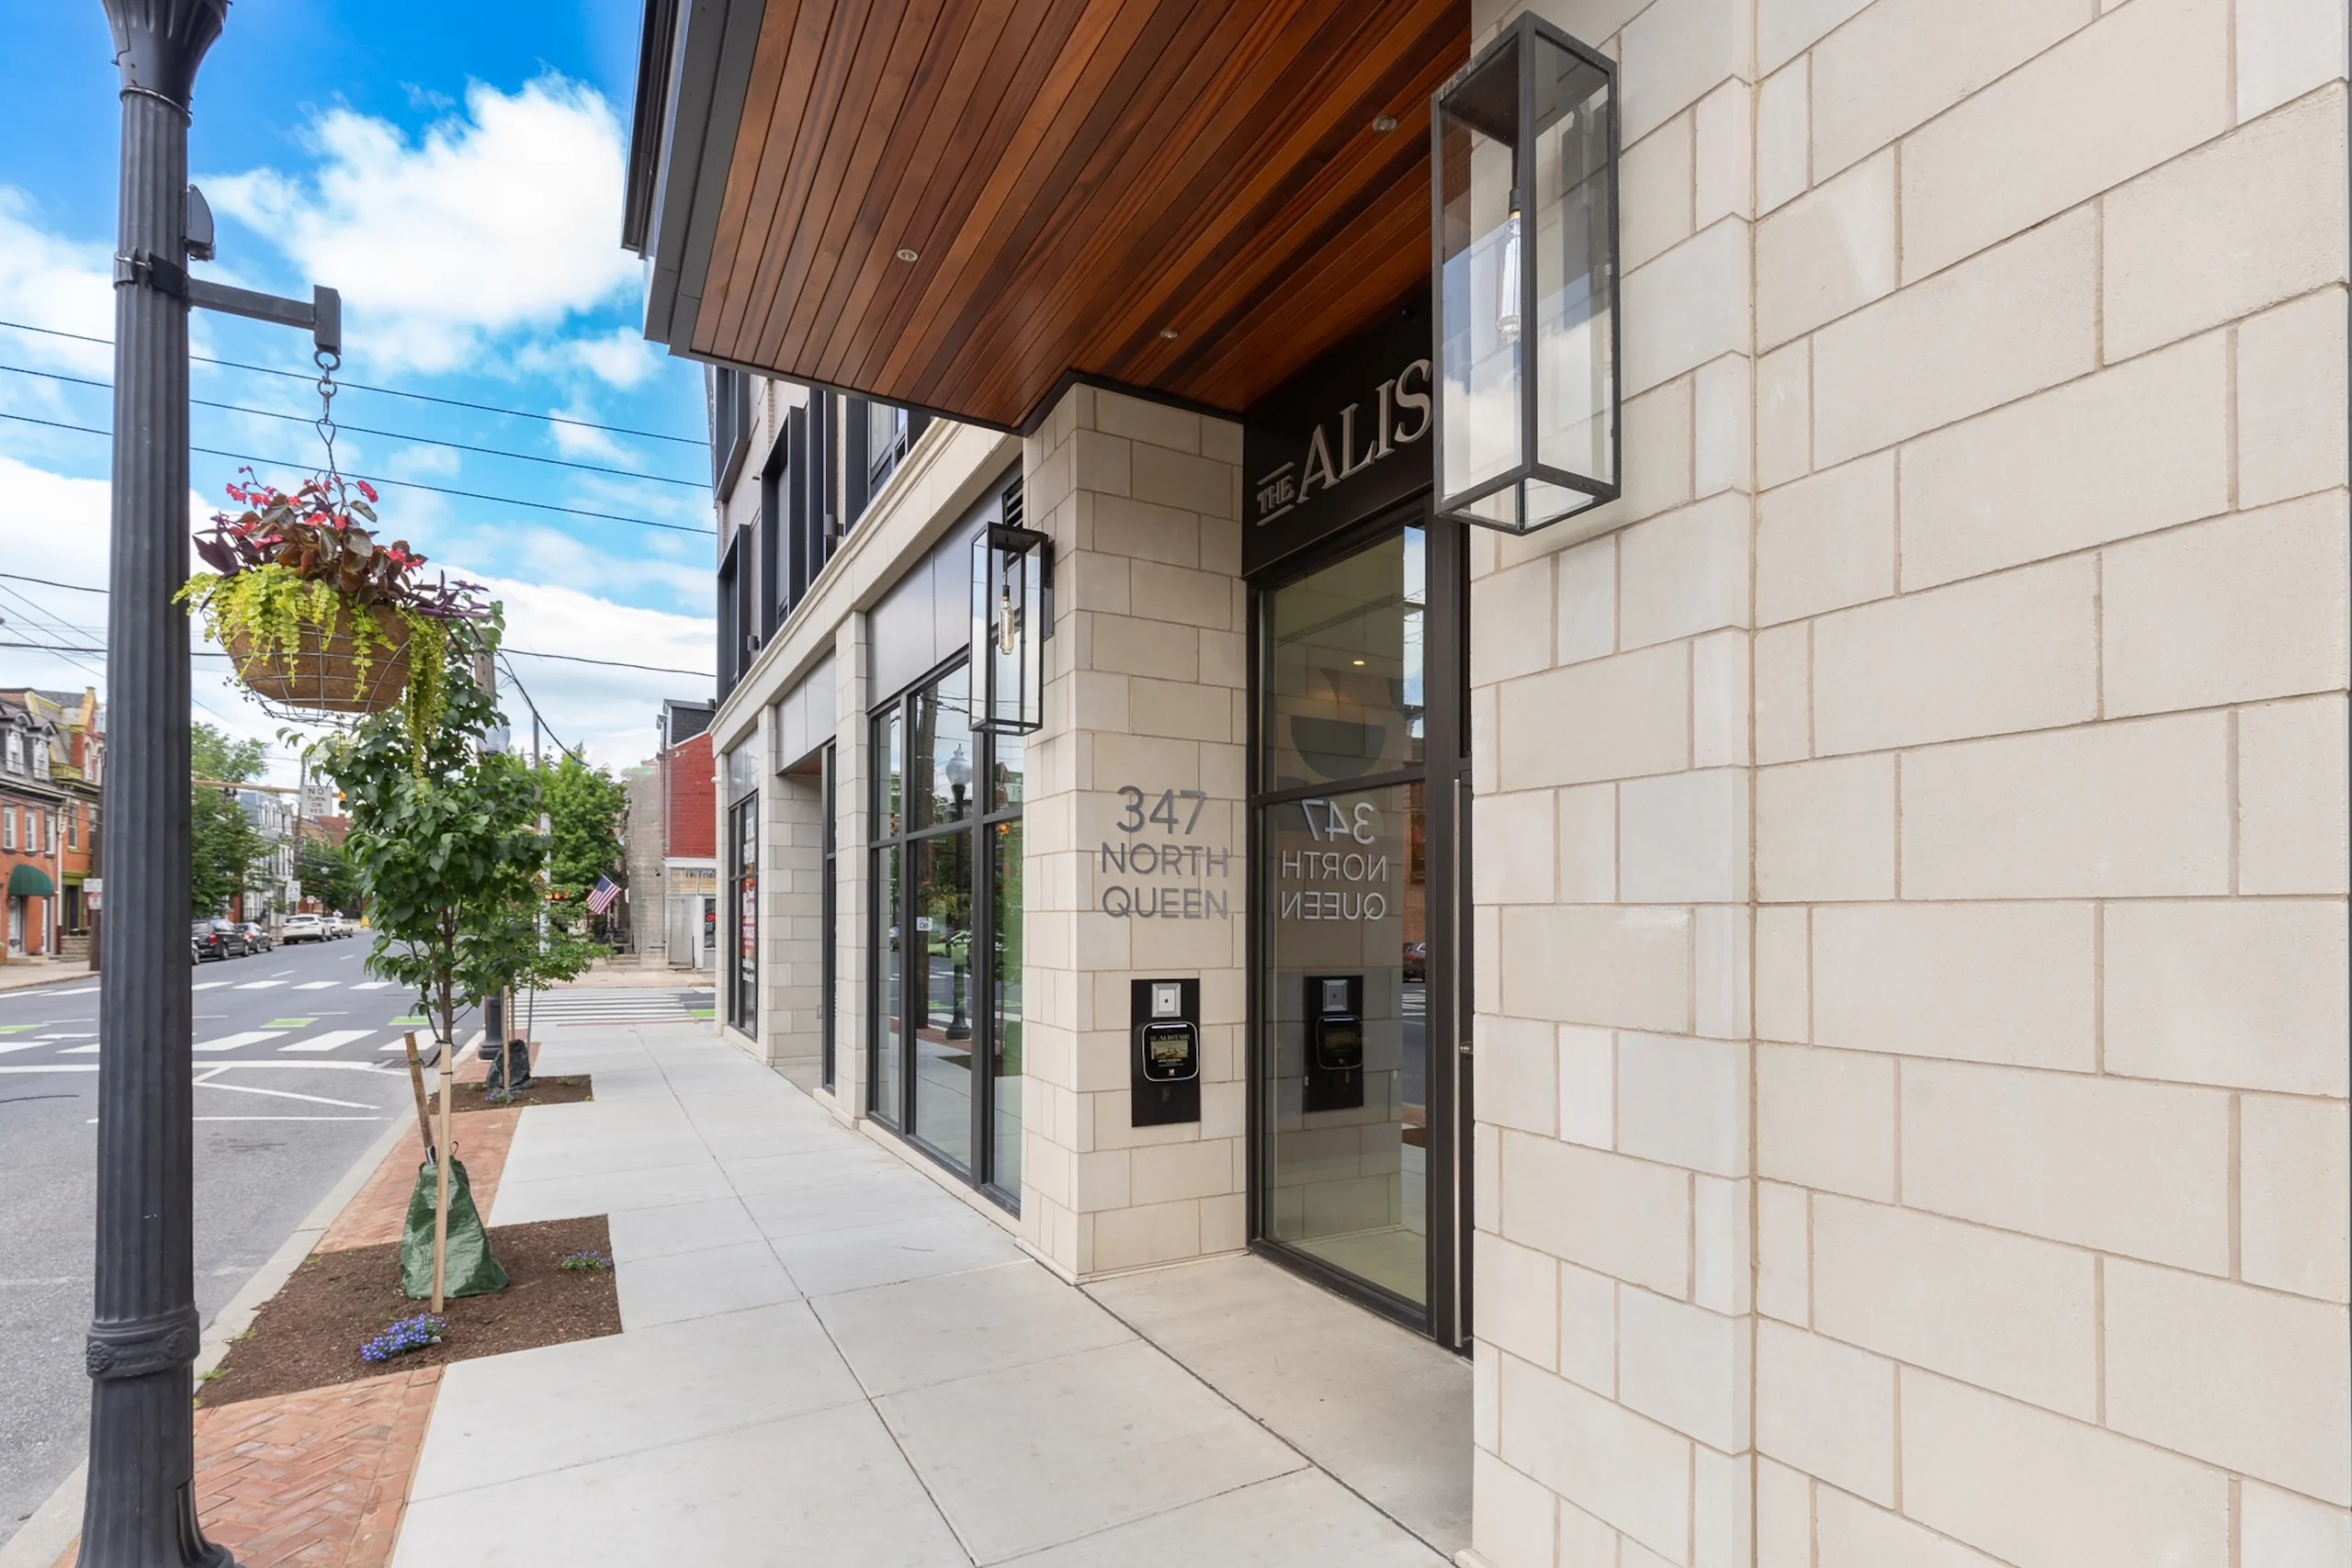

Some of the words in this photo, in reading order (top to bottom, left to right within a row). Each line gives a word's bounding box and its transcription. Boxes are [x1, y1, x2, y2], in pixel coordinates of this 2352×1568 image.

[1257, 475, 1295, 513] THE
[1296, 358, 1433, 503] ALIS
[308, 787, 324, 795] NO
[1116, 785, 1206, 835] 347
[1102, 841, 1227, 878] NORTH
[1102, 886, 1227, 919] QUEEN
